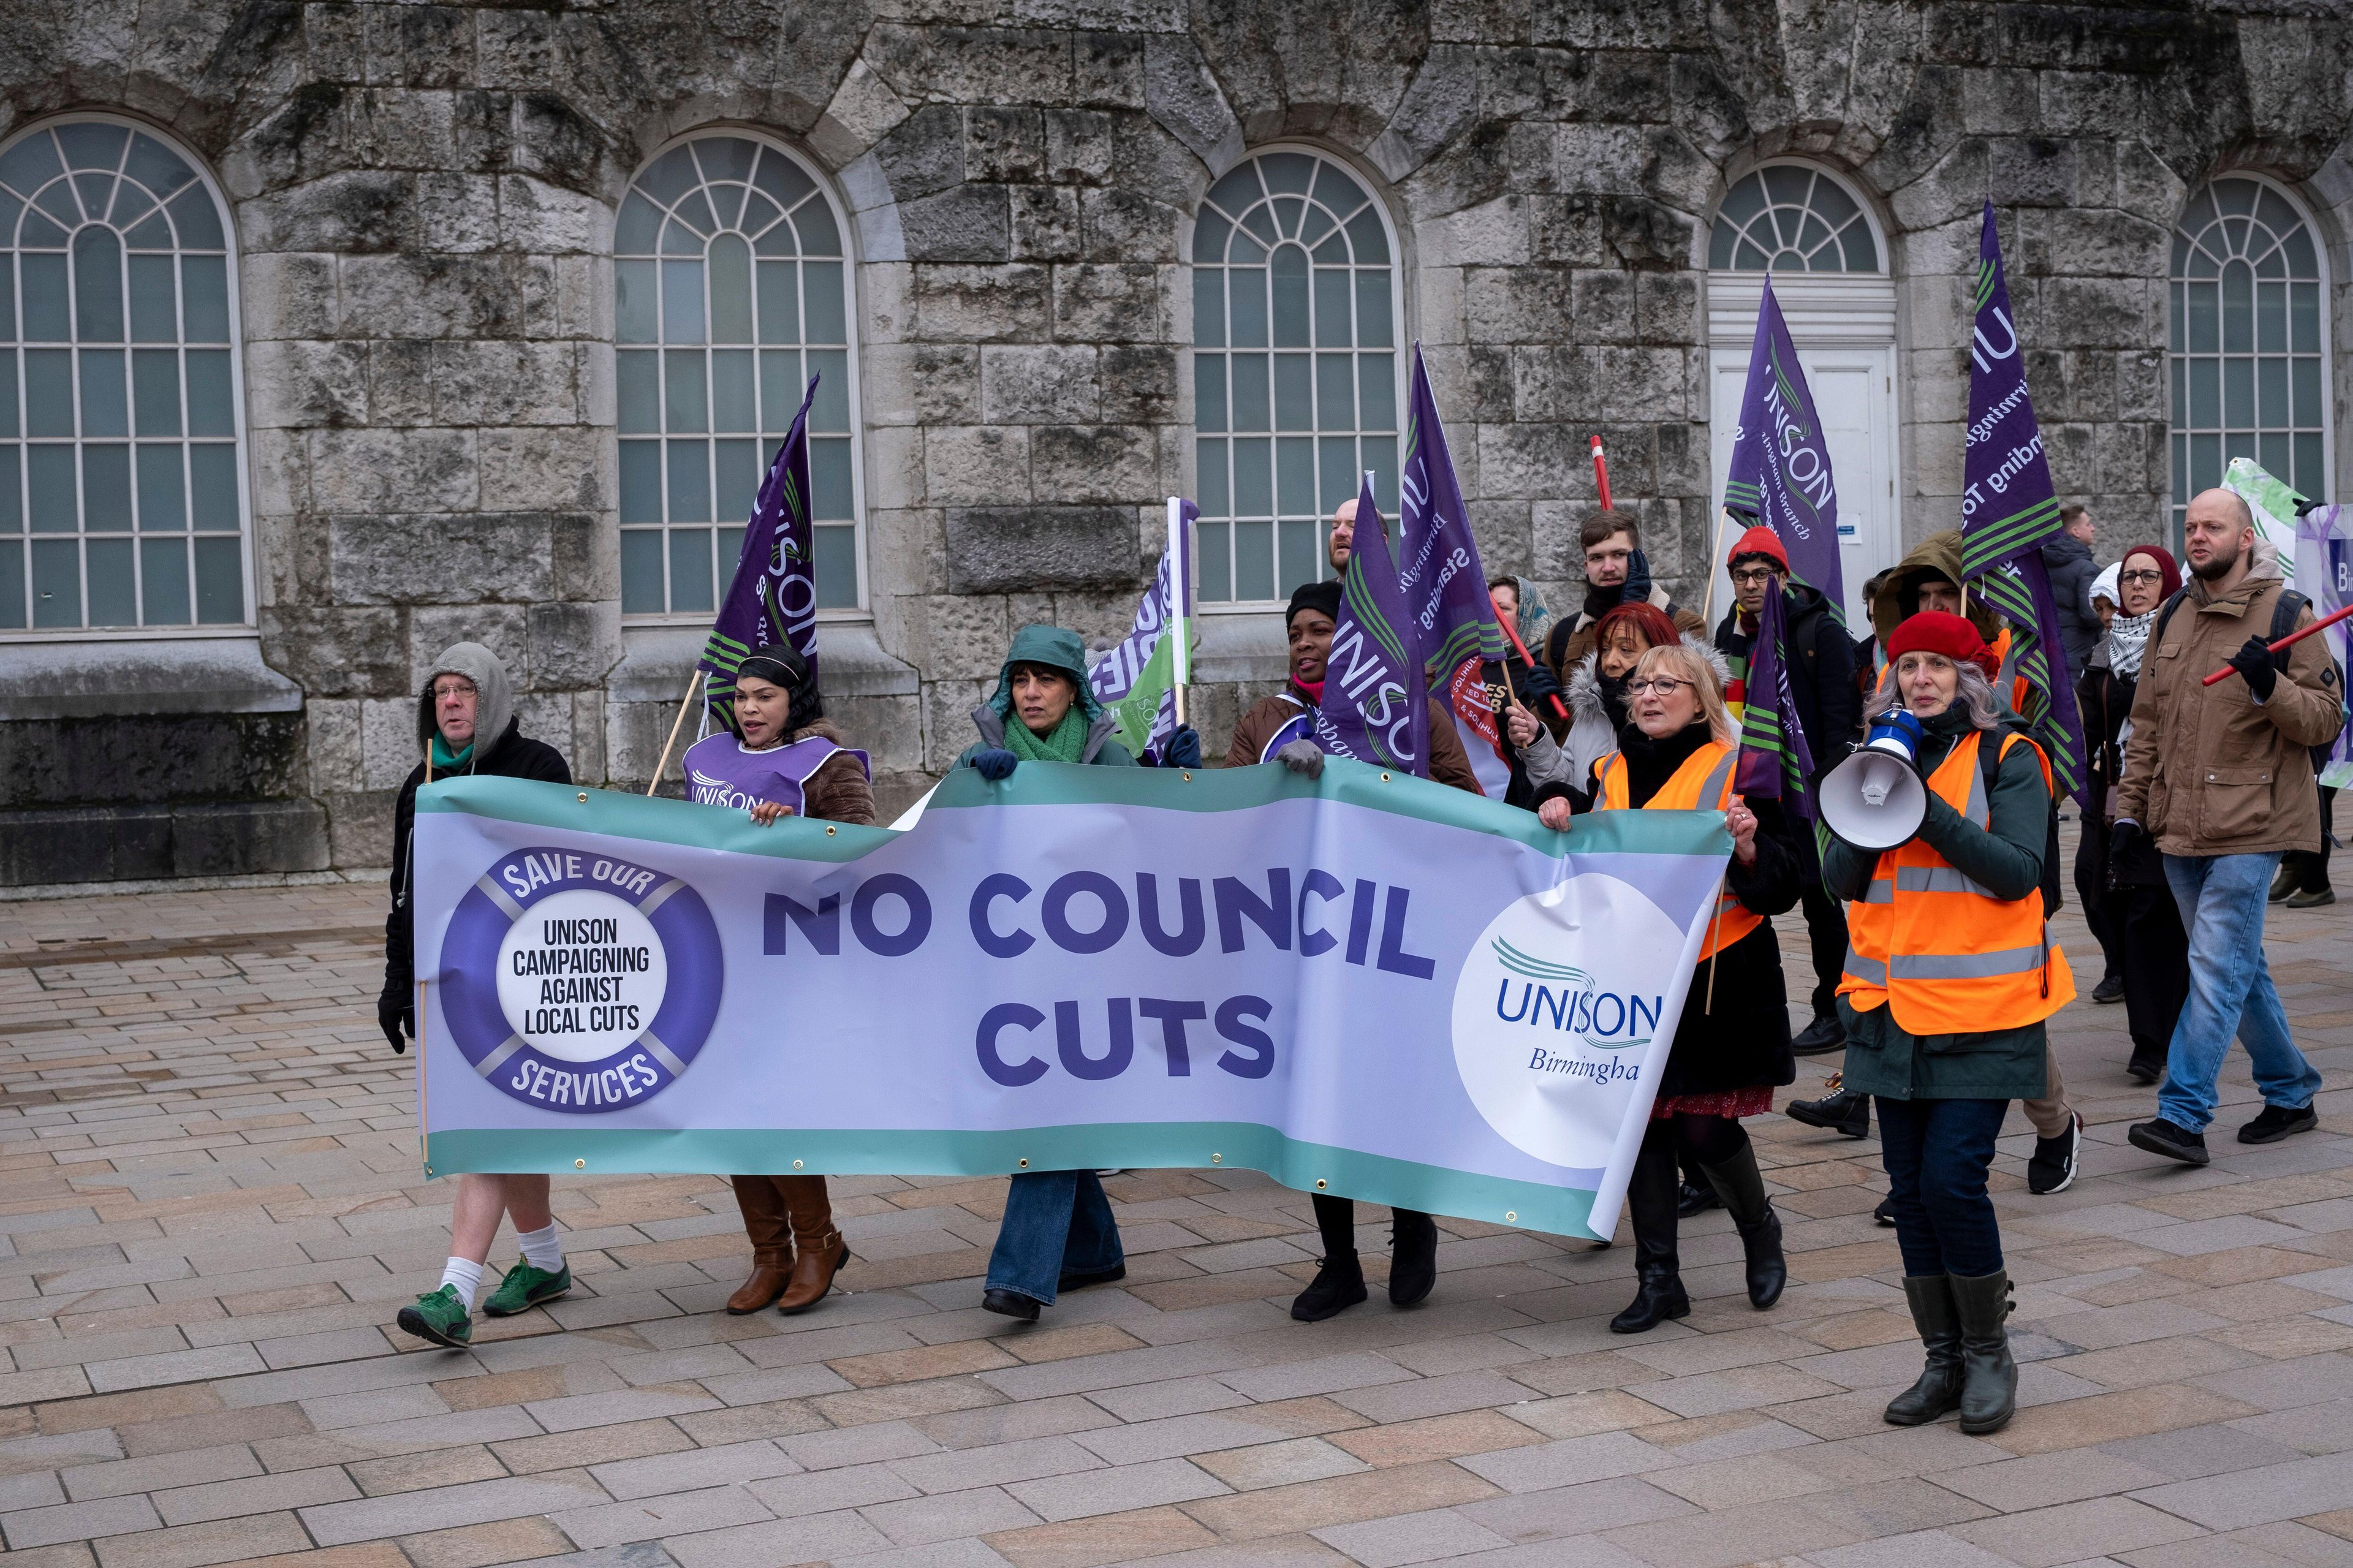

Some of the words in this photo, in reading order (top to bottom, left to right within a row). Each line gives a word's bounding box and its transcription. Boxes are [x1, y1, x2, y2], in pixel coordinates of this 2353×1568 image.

[1779, 490, 1810, 540] Branch
[1482, 694, 1490, 703] 18
[1485, 683, 1508, 699] ES
[1468, 710, 1499, 741] SOLIHULL
[502, 852, 583, 898] SAVE
[591, 860, 656, 896] OUR
[544, 918, 618, 946] UNISON
[763, 872, 933, 957] NO
[969, 867, 1436, 980] COUNCIL
[513, 946, 650, 976] CAMPAIGNING
[540, 976, 624, 1005] AGAINST
[1496, 978, 1662, 1037] UNISON
[524, 1007, 586, 1034] LOCAL
[589, 1004, 640, 1032] CUTS
[976, 994, 1275, 1088] CUTS
[511, 1053, 658, 1105] SERVICES
[1527, 1047, 1639, 1085] Birmingha
